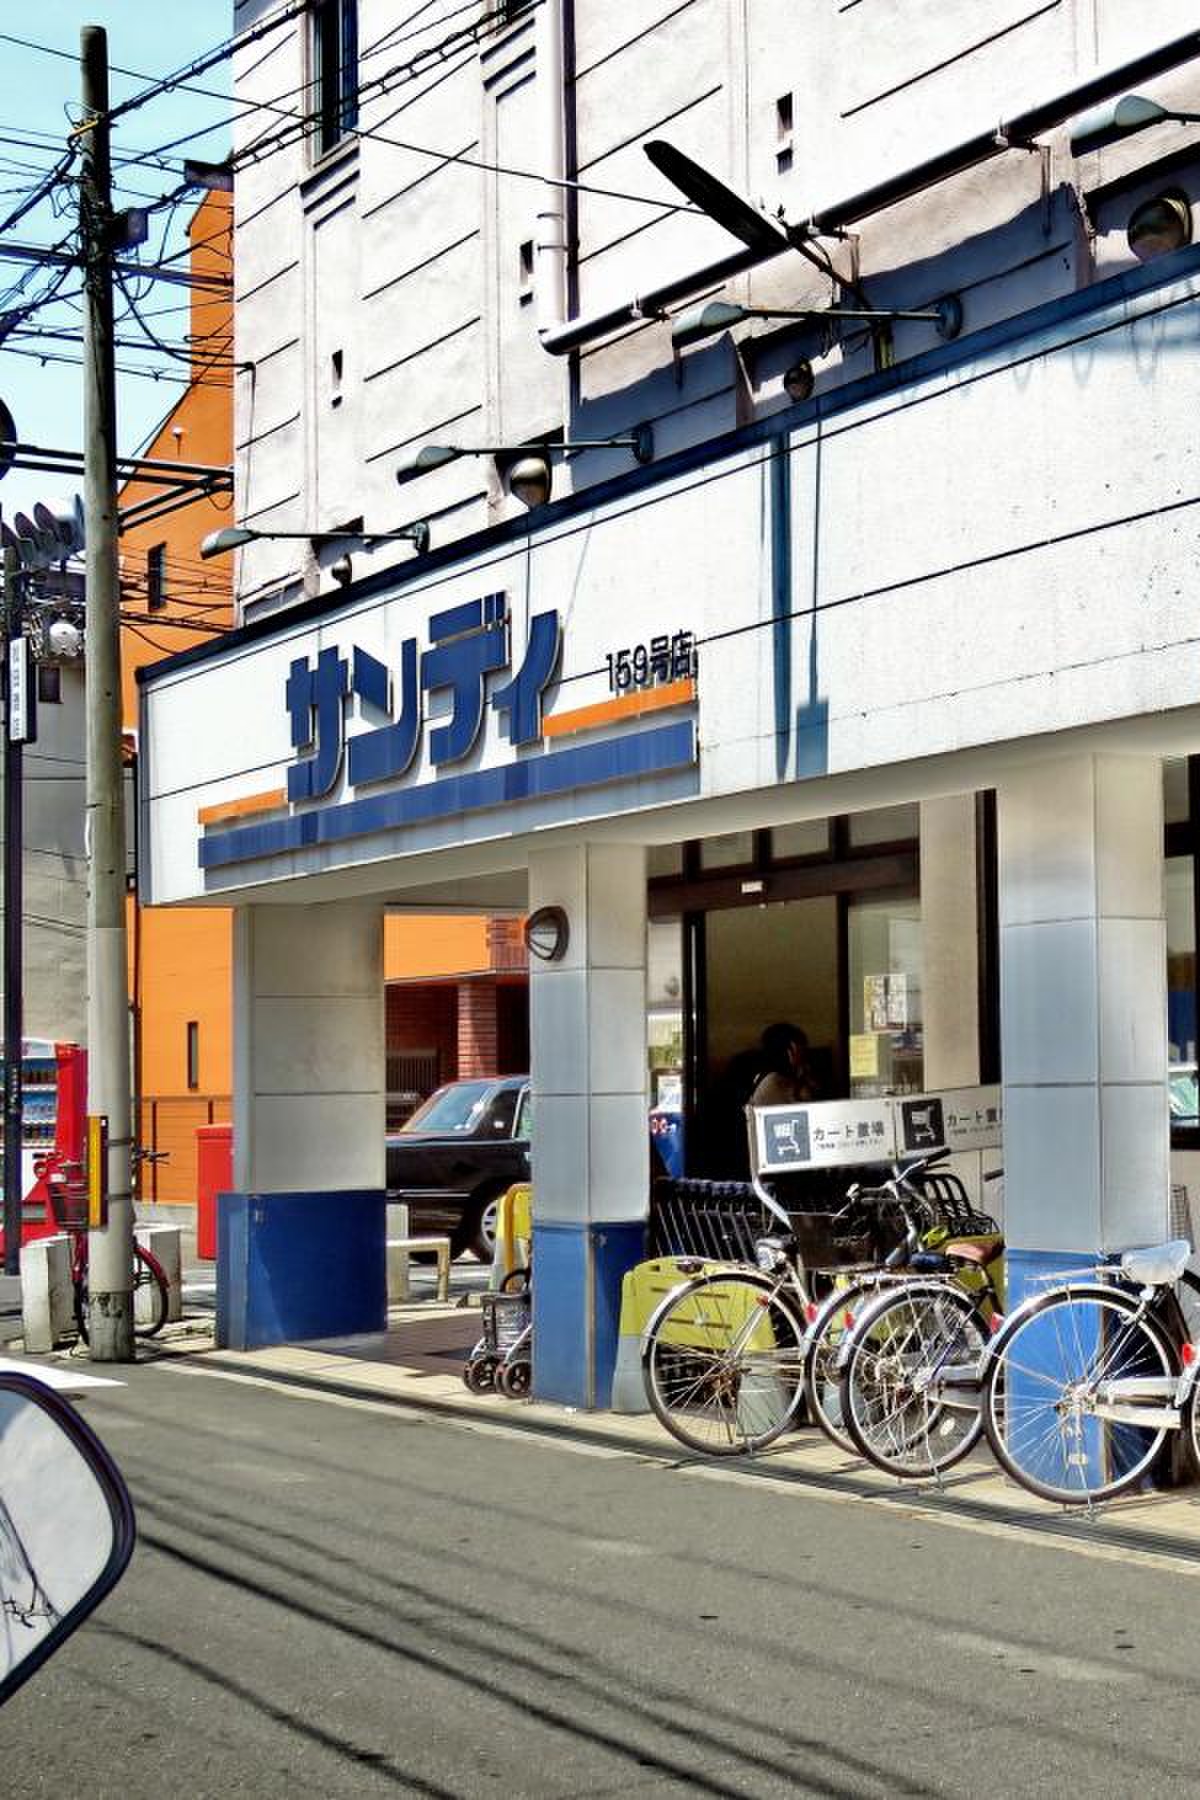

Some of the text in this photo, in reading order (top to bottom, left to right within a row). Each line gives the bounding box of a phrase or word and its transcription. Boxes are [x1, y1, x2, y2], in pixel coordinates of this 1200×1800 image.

[606, 629, 692, 692] 159号店
[286, 590, 557, 801] サンディ
[813, 1119, 885, 1142] カート置場
